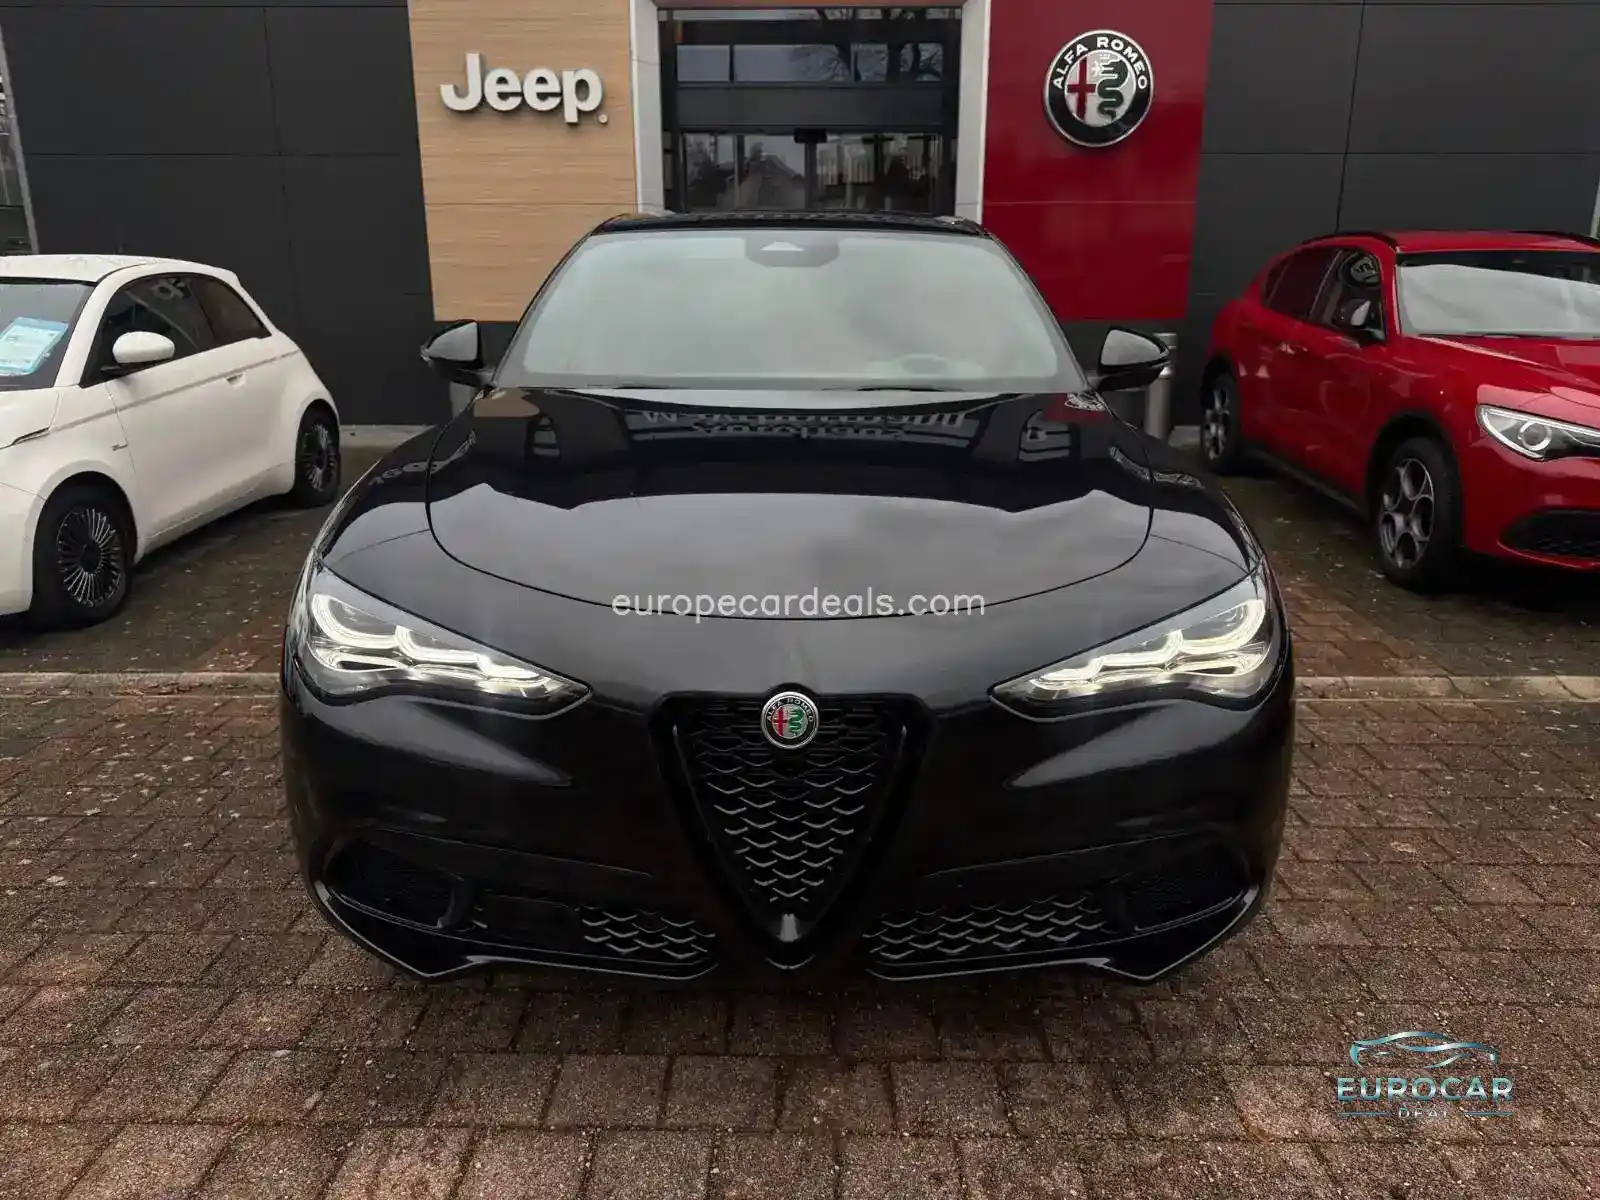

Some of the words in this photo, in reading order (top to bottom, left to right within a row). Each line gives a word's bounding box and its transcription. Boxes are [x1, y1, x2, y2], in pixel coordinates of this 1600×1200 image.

[440, 52, 603, 123] Jeep
[1052, 43, 1088, 89] ALFA
[1096, 36, 1148, 90] ROMEO
